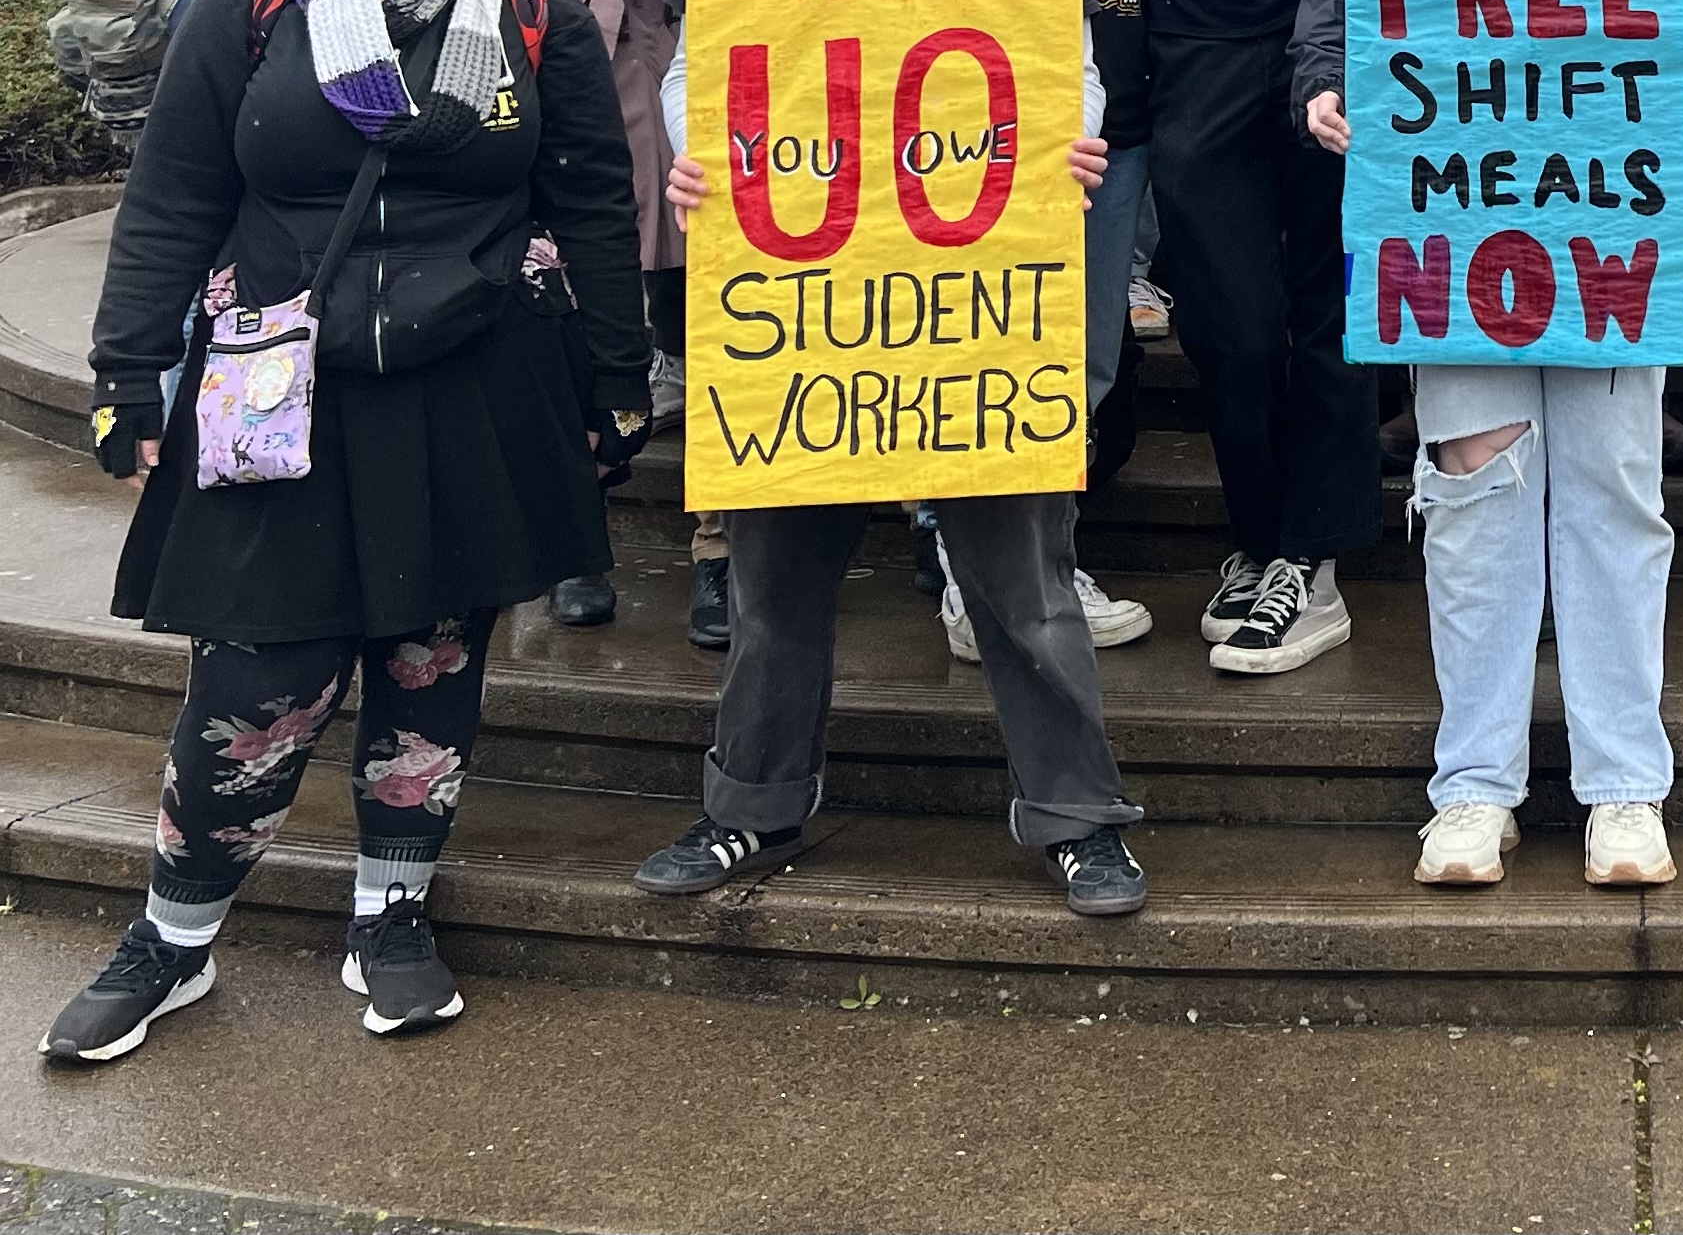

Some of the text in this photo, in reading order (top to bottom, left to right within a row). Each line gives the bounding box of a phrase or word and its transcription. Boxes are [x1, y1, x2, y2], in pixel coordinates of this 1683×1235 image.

[1390, 52, 1659, 134] SHIFT
[733, 122, 1017, 179] YOU OWE
[1411, 149, 1666, 217] MEALS
[721, 262, 1065, 361] STUDENT
[1377, 229, 1659, 347] NOW
[709, 364, 1078, 466] WORKERS
